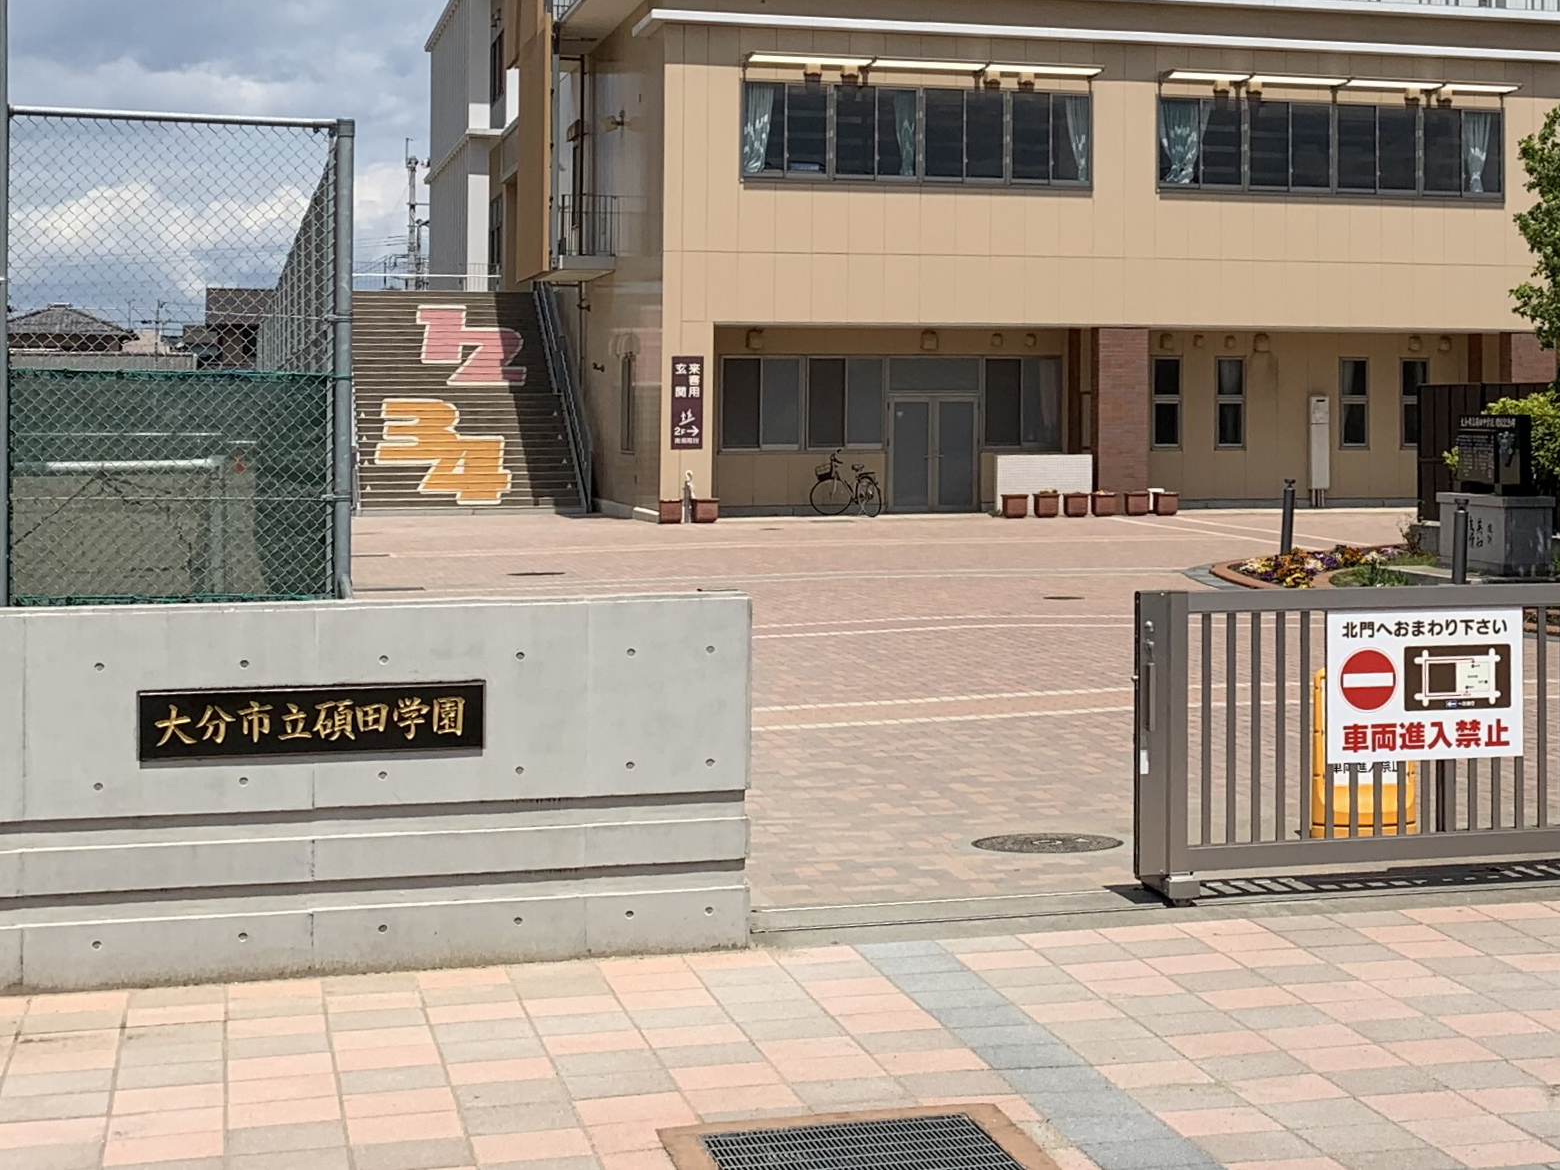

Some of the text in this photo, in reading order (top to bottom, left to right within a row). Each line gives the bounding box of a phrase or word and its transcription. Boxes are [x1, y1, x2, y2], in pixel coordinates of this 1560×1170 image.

[675, 363, 687, 398] 玄関
[674, 426, 686, 436] 2F
[1341, 618, 1508, 639] 北門へおまわり下さい
[154, 695, 466, 748] 大分市立碩田学園
[1341, 718, 1511, 753] 車両進入禁止
